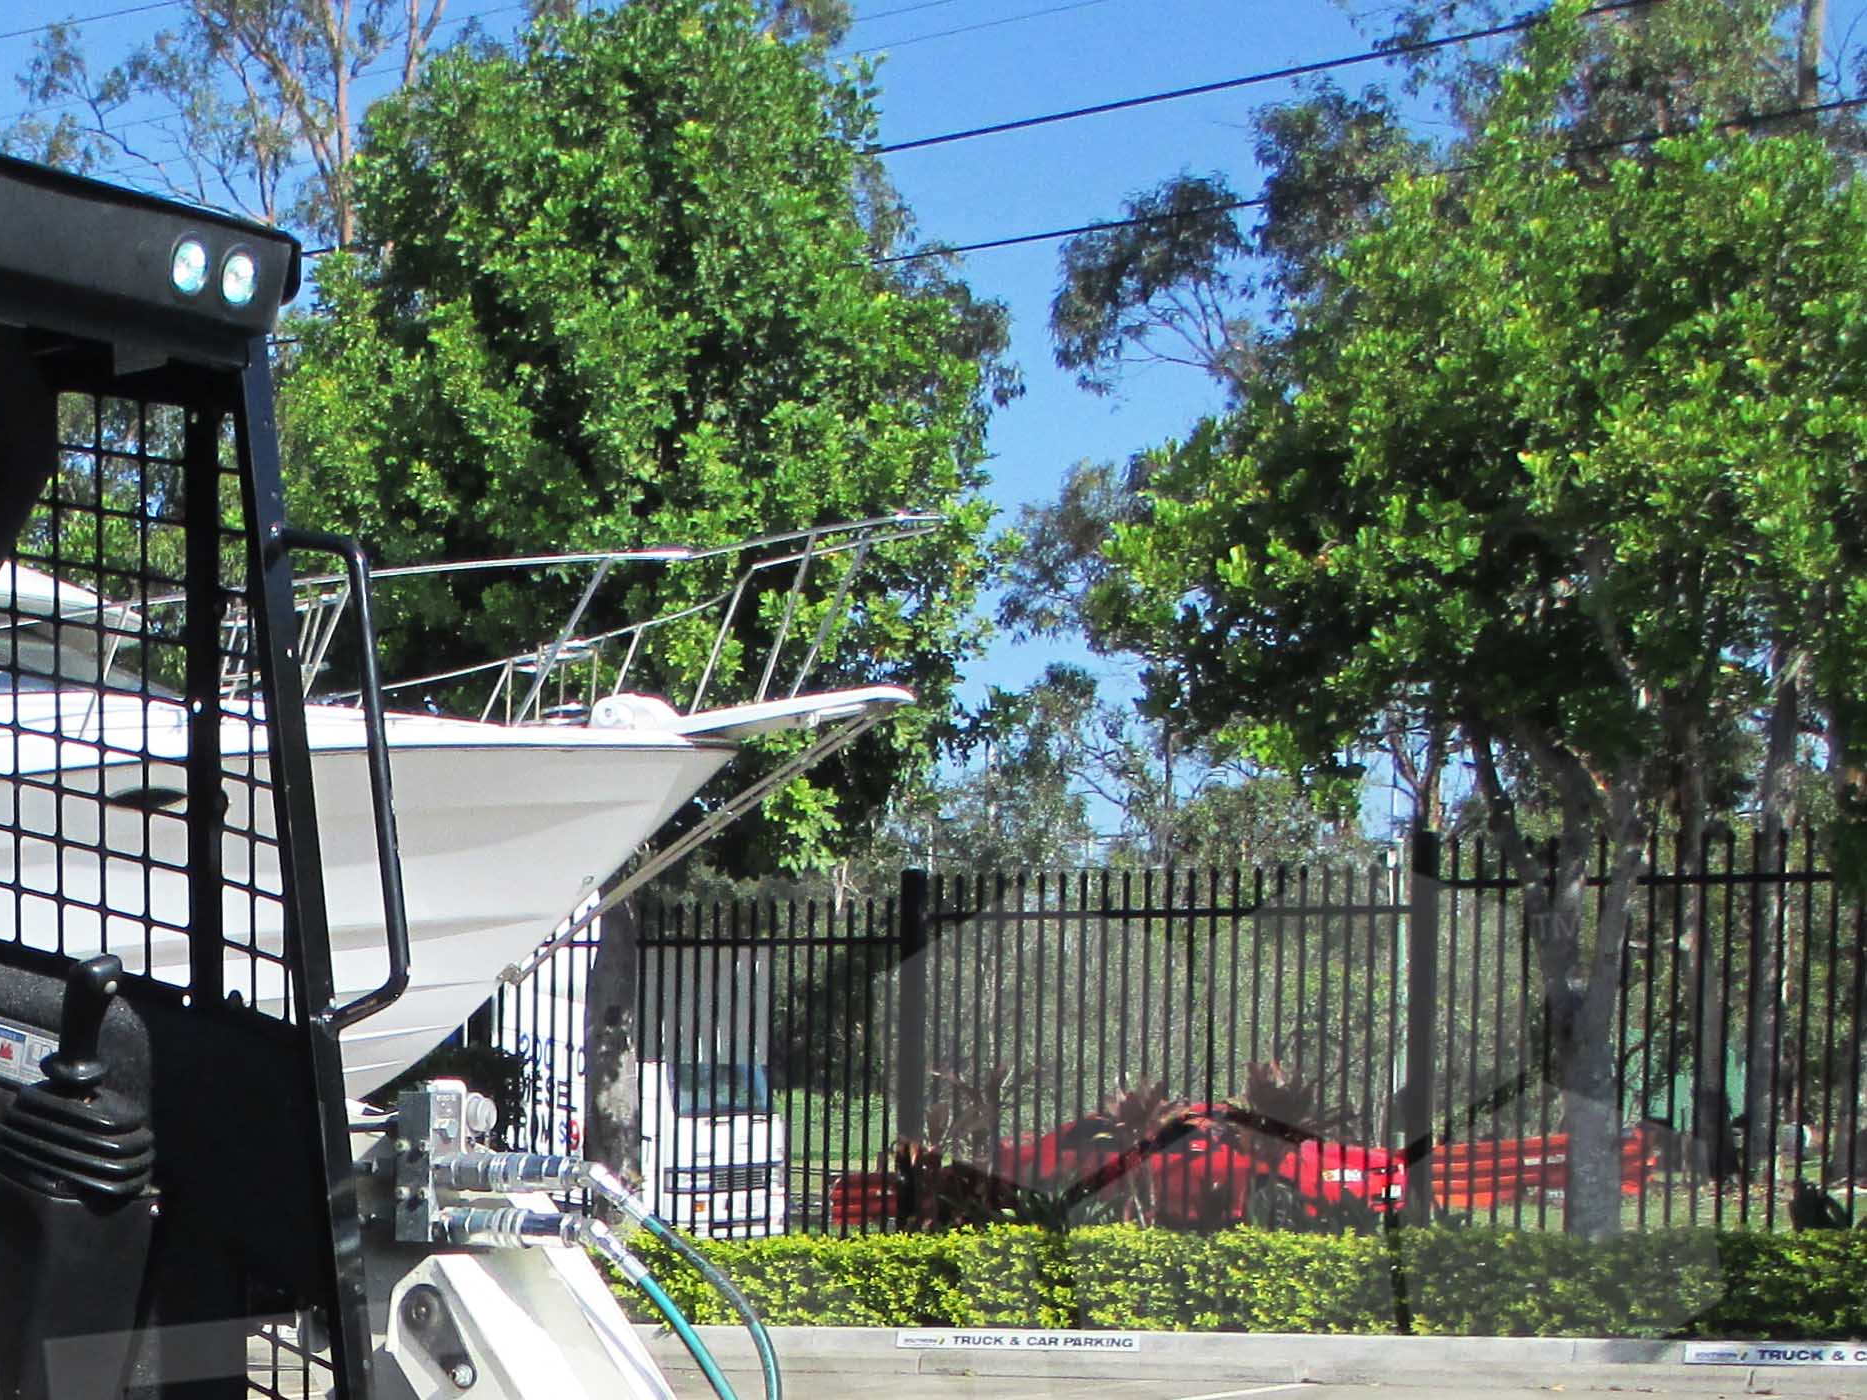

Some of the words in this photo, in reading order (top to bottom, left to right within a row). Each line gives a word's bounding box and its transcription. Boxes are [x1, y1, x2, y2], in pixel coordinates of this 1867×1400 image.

[952, 1335, 1004, 1346] TRUCK
[1009, 1336, 1020, 1346] &
[1027, 1336, 1058, 1346] CAR
[1063, 1337, 1134, 1348] PARKING
[1758, 1349, 1824, 1361] TRUCK
[1832, 1350, 1845, 1361] &
